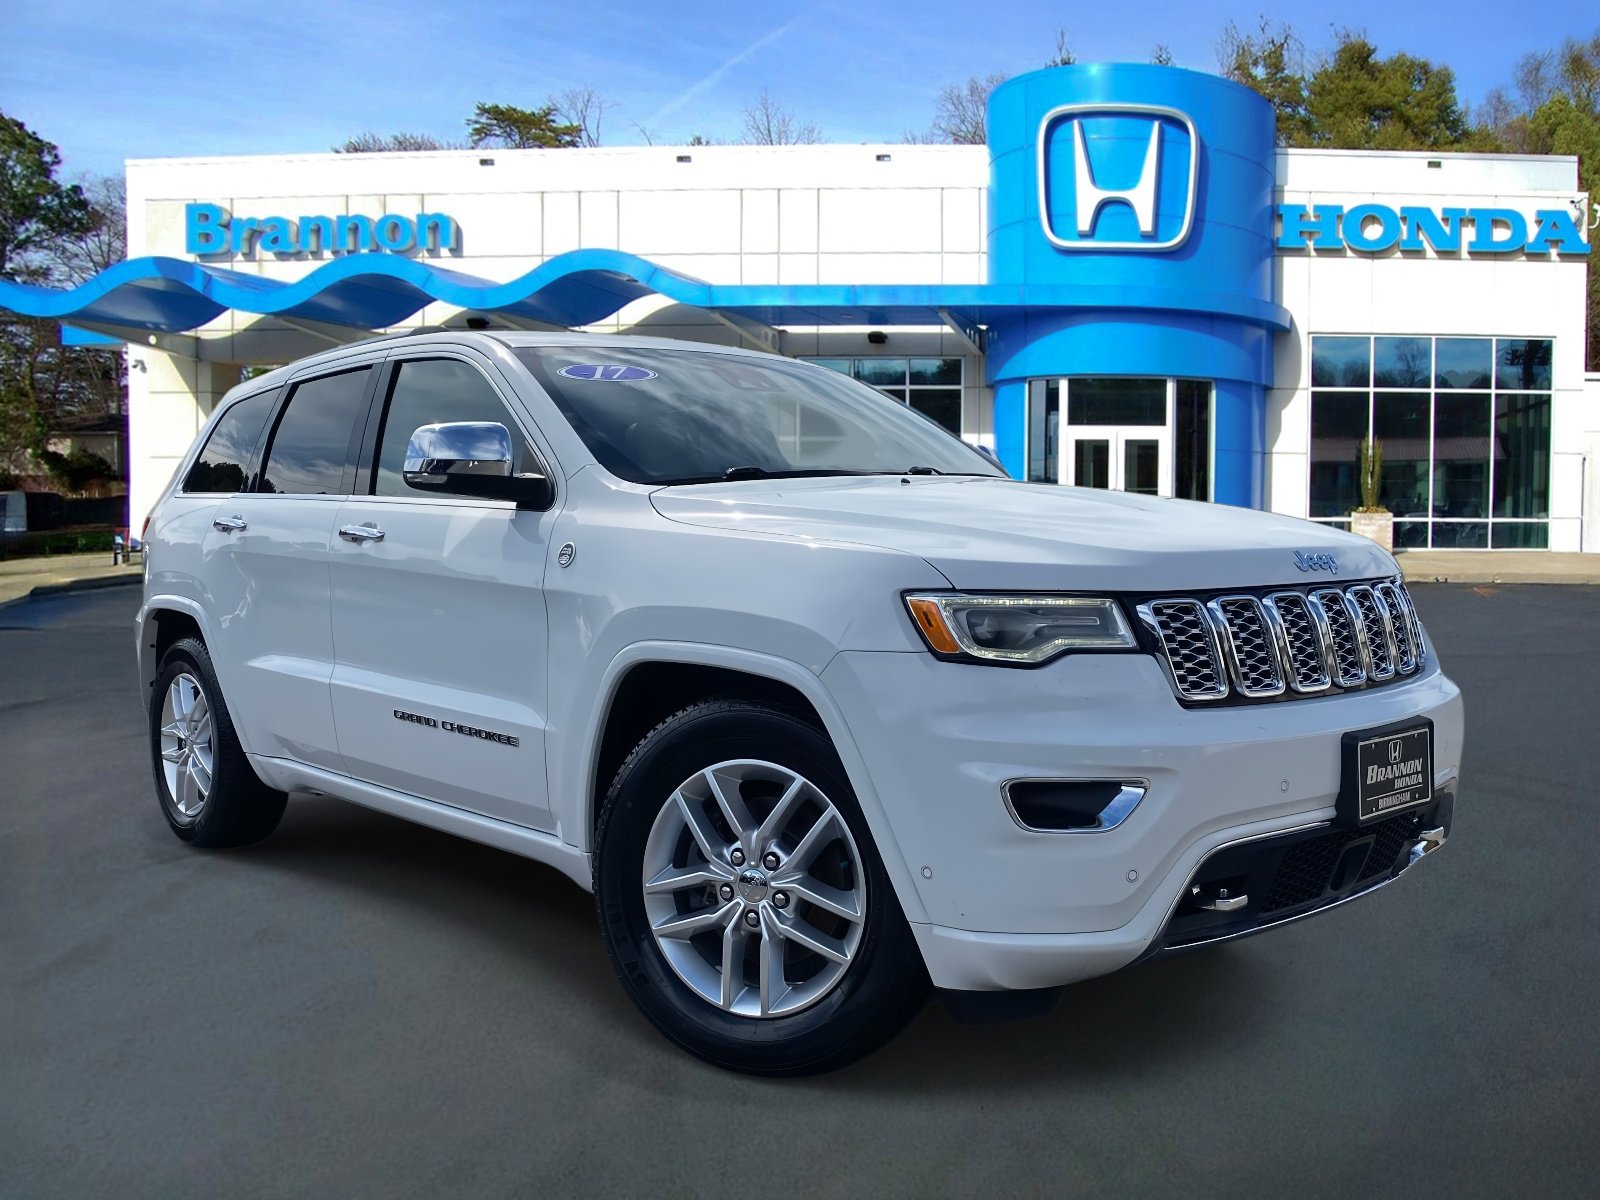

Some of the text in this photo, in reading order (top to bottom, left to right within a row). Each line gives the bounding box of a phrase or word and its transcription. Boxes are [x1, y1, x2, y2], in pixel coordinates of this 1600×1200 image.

[186, 203, 457, 255] Brannon
[1277, 204, 1591, 254] HONDA
[1292, 550, 1338, 575] Jeep
[393, 709, 519, 747] GRAND CHEROKEE
[1366, 758, 1423, 785] BRANNON
[1394, 773, 1423, 789] HONDA
